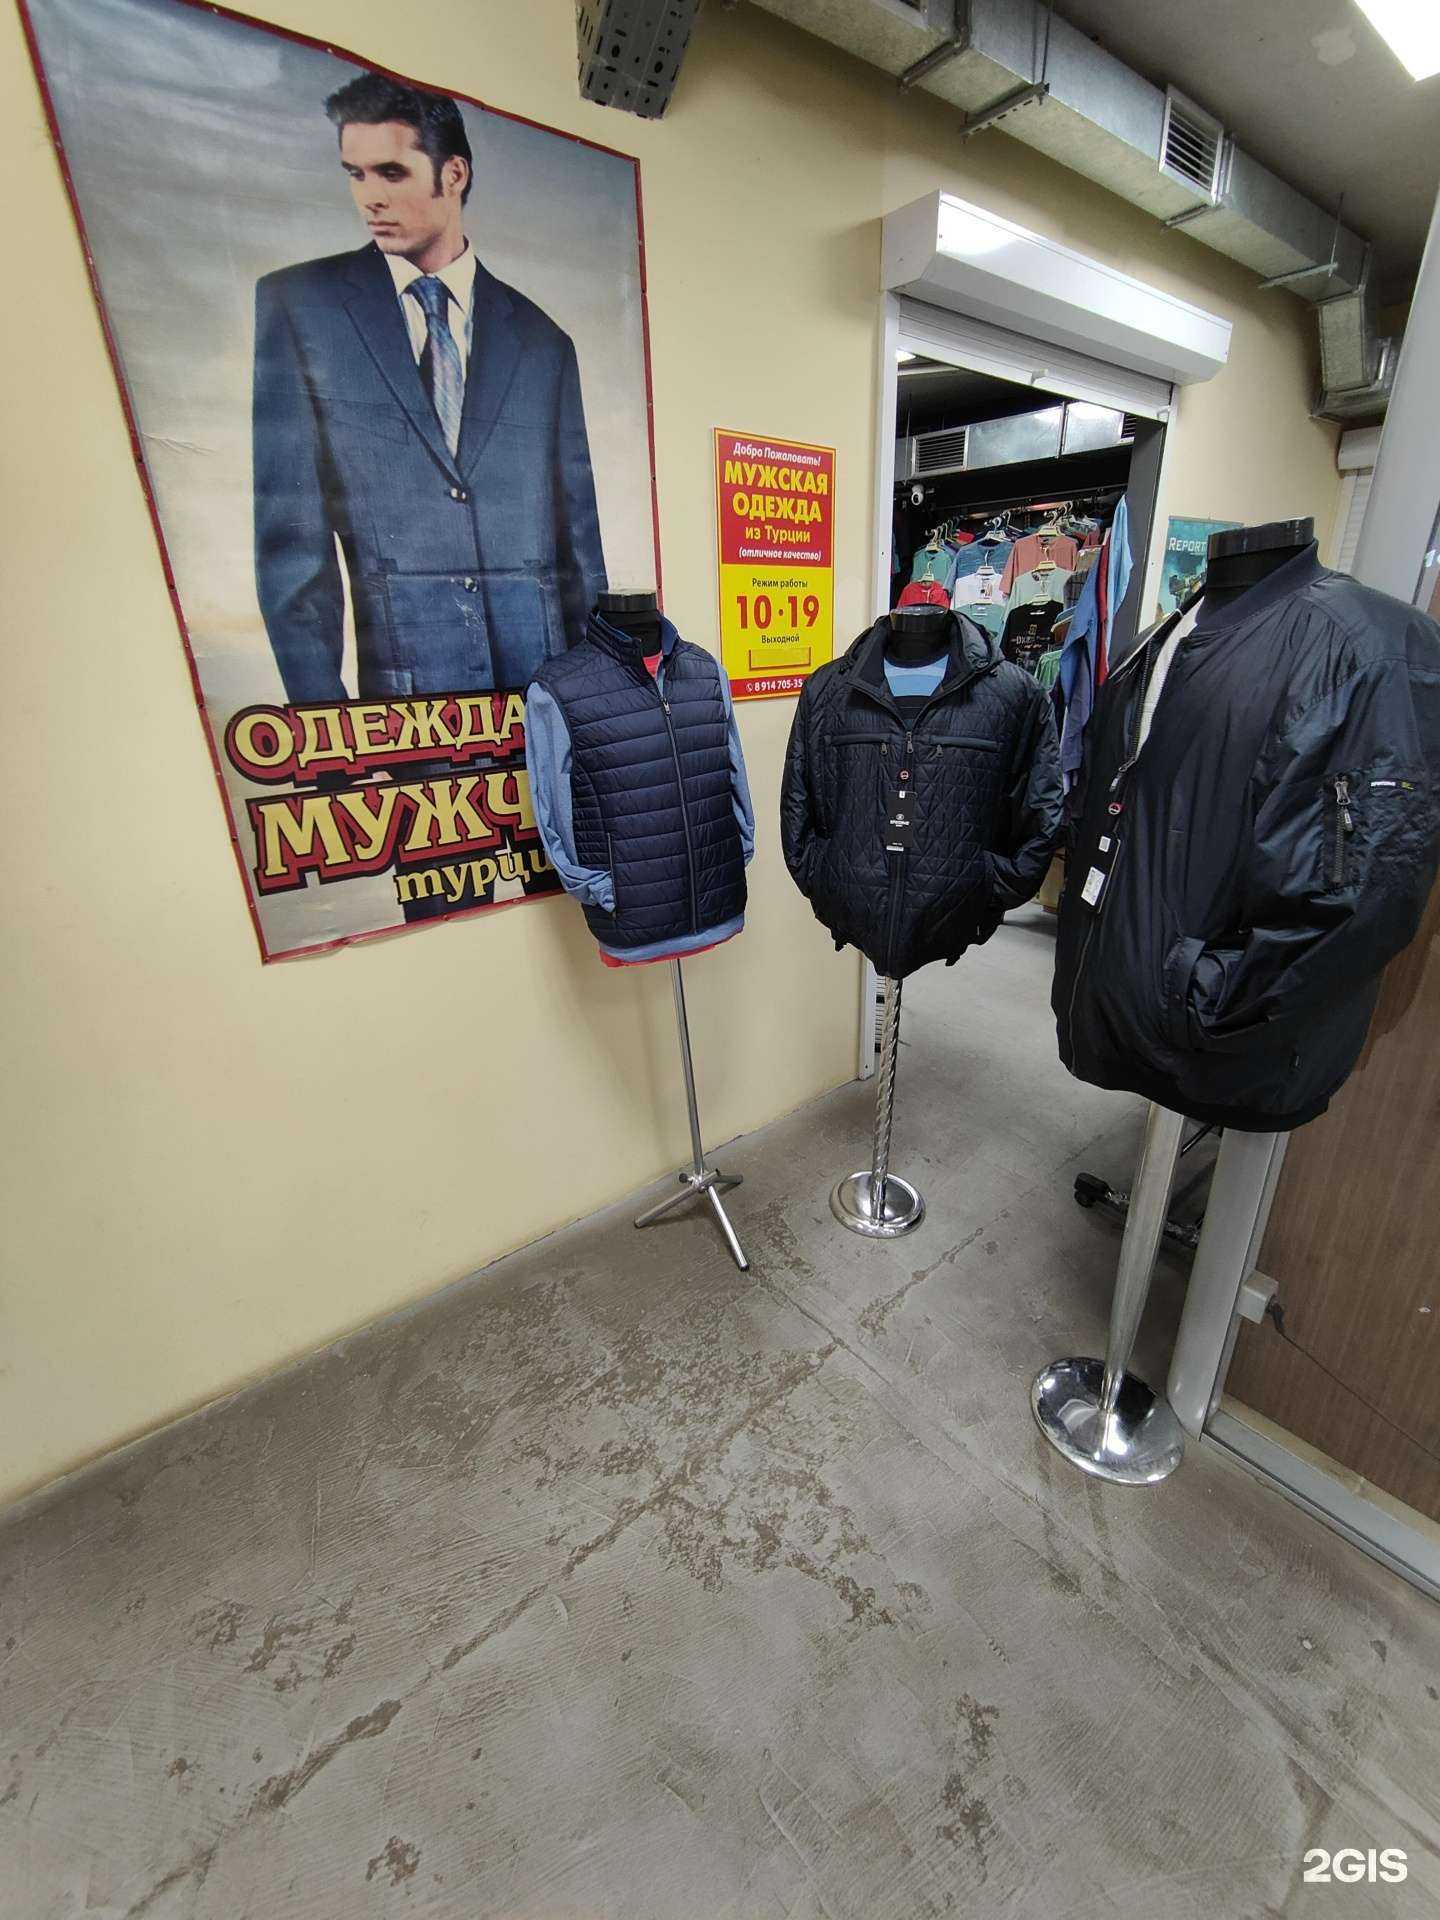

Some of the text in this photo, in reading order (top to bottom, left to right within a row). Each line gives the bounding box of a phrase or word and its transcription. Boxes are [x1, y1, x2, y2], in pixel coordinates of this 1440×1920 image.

[733, 442, 821, 466] Добро Пожаловать!
[724, 460, 828, 495] МУЖСКАЯ
[733, 492, 822, 525] ОДЕЖДА
[745, 525, 811, 544] из Турции
[739, 547, 822, 562] (отличное качество)
[752, 578, 808, 588] Режим работы
[761, 633, 800, 644] Выходной
[233, 693, 527, 768] ОДЕЖДА
